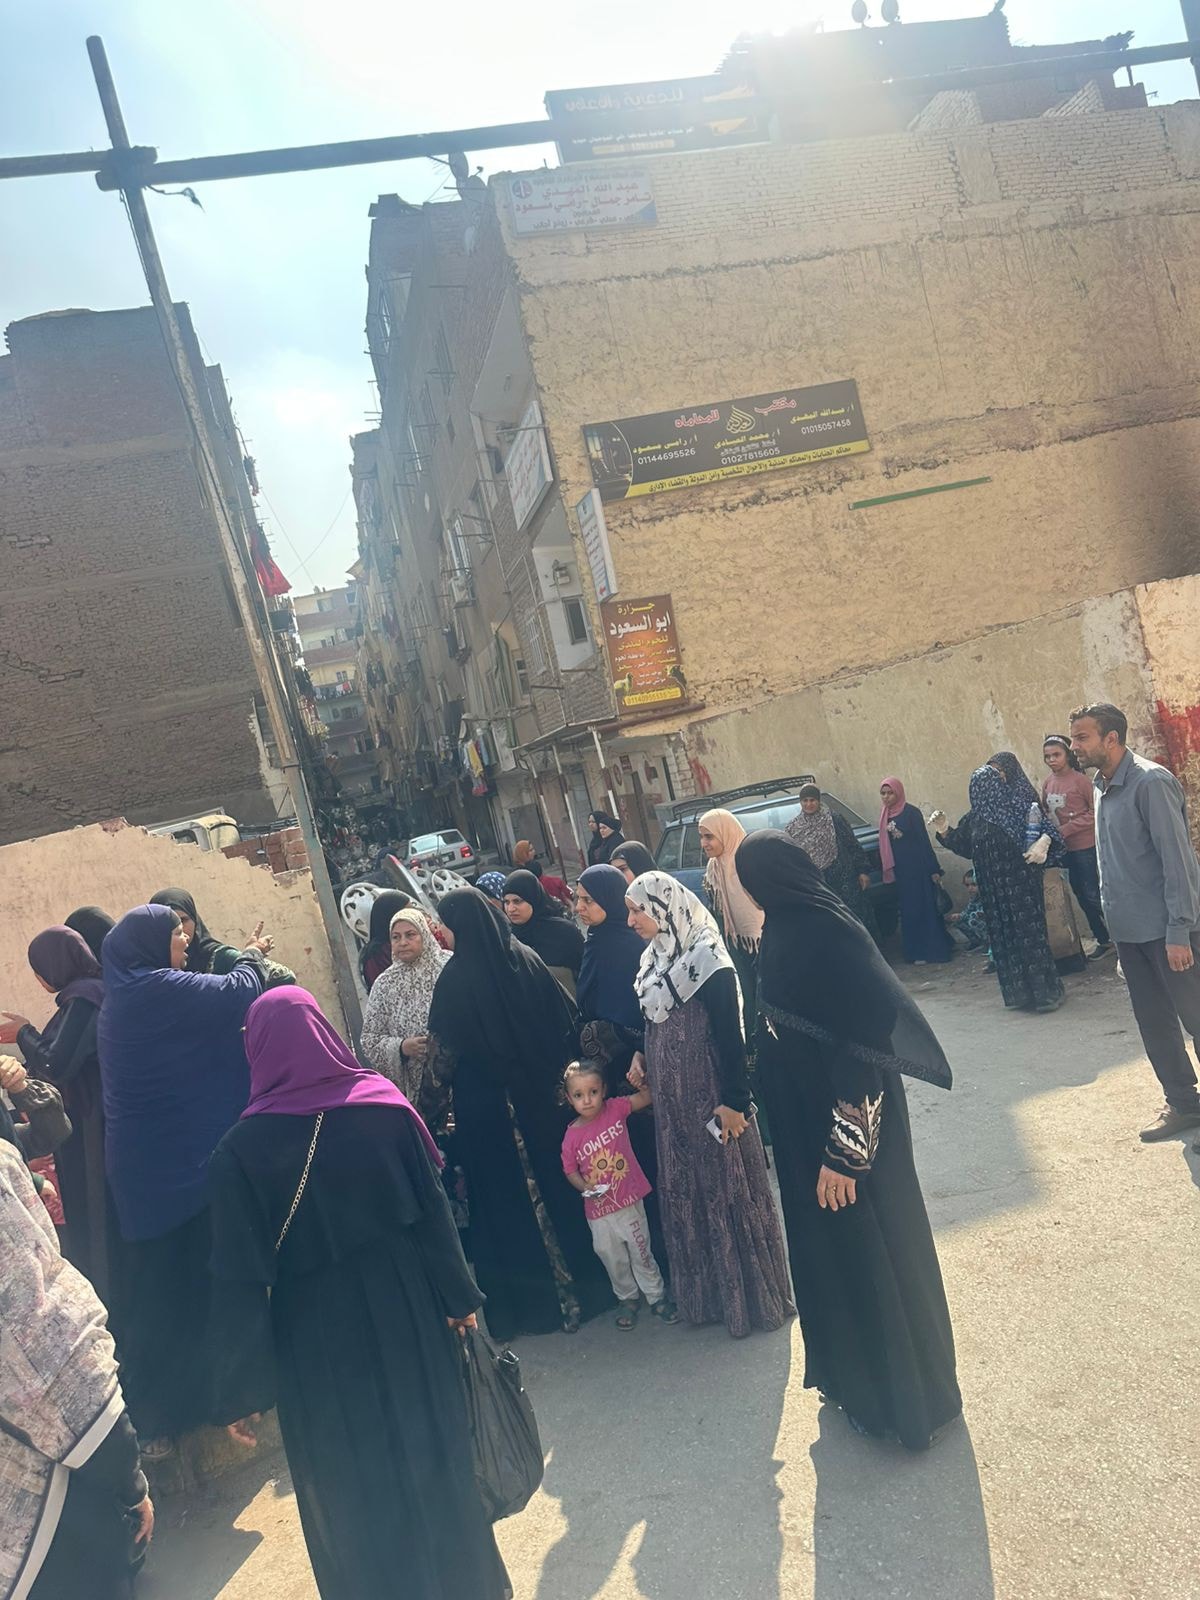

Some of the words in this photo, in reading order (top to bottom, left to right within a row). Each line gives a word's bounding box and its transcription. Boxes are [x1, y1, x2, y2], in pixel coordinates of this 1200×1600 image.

[754, 396, 797, 416] مكتب
[748, 432, 770, 442] محمد
[633, 443, 662, 455] مسعود
[637, 448, 697, 466] 01144695526
[721, 446, 780, 465] 01027815605
[617, 602, 655, 615] جزارة
[610, 613, 653, 638] السعود
[655, 610, 671, 633] ابو
[576, 1119, 624, 1161] LOWERS
[592, 1203, 616, 1218] EVERY
